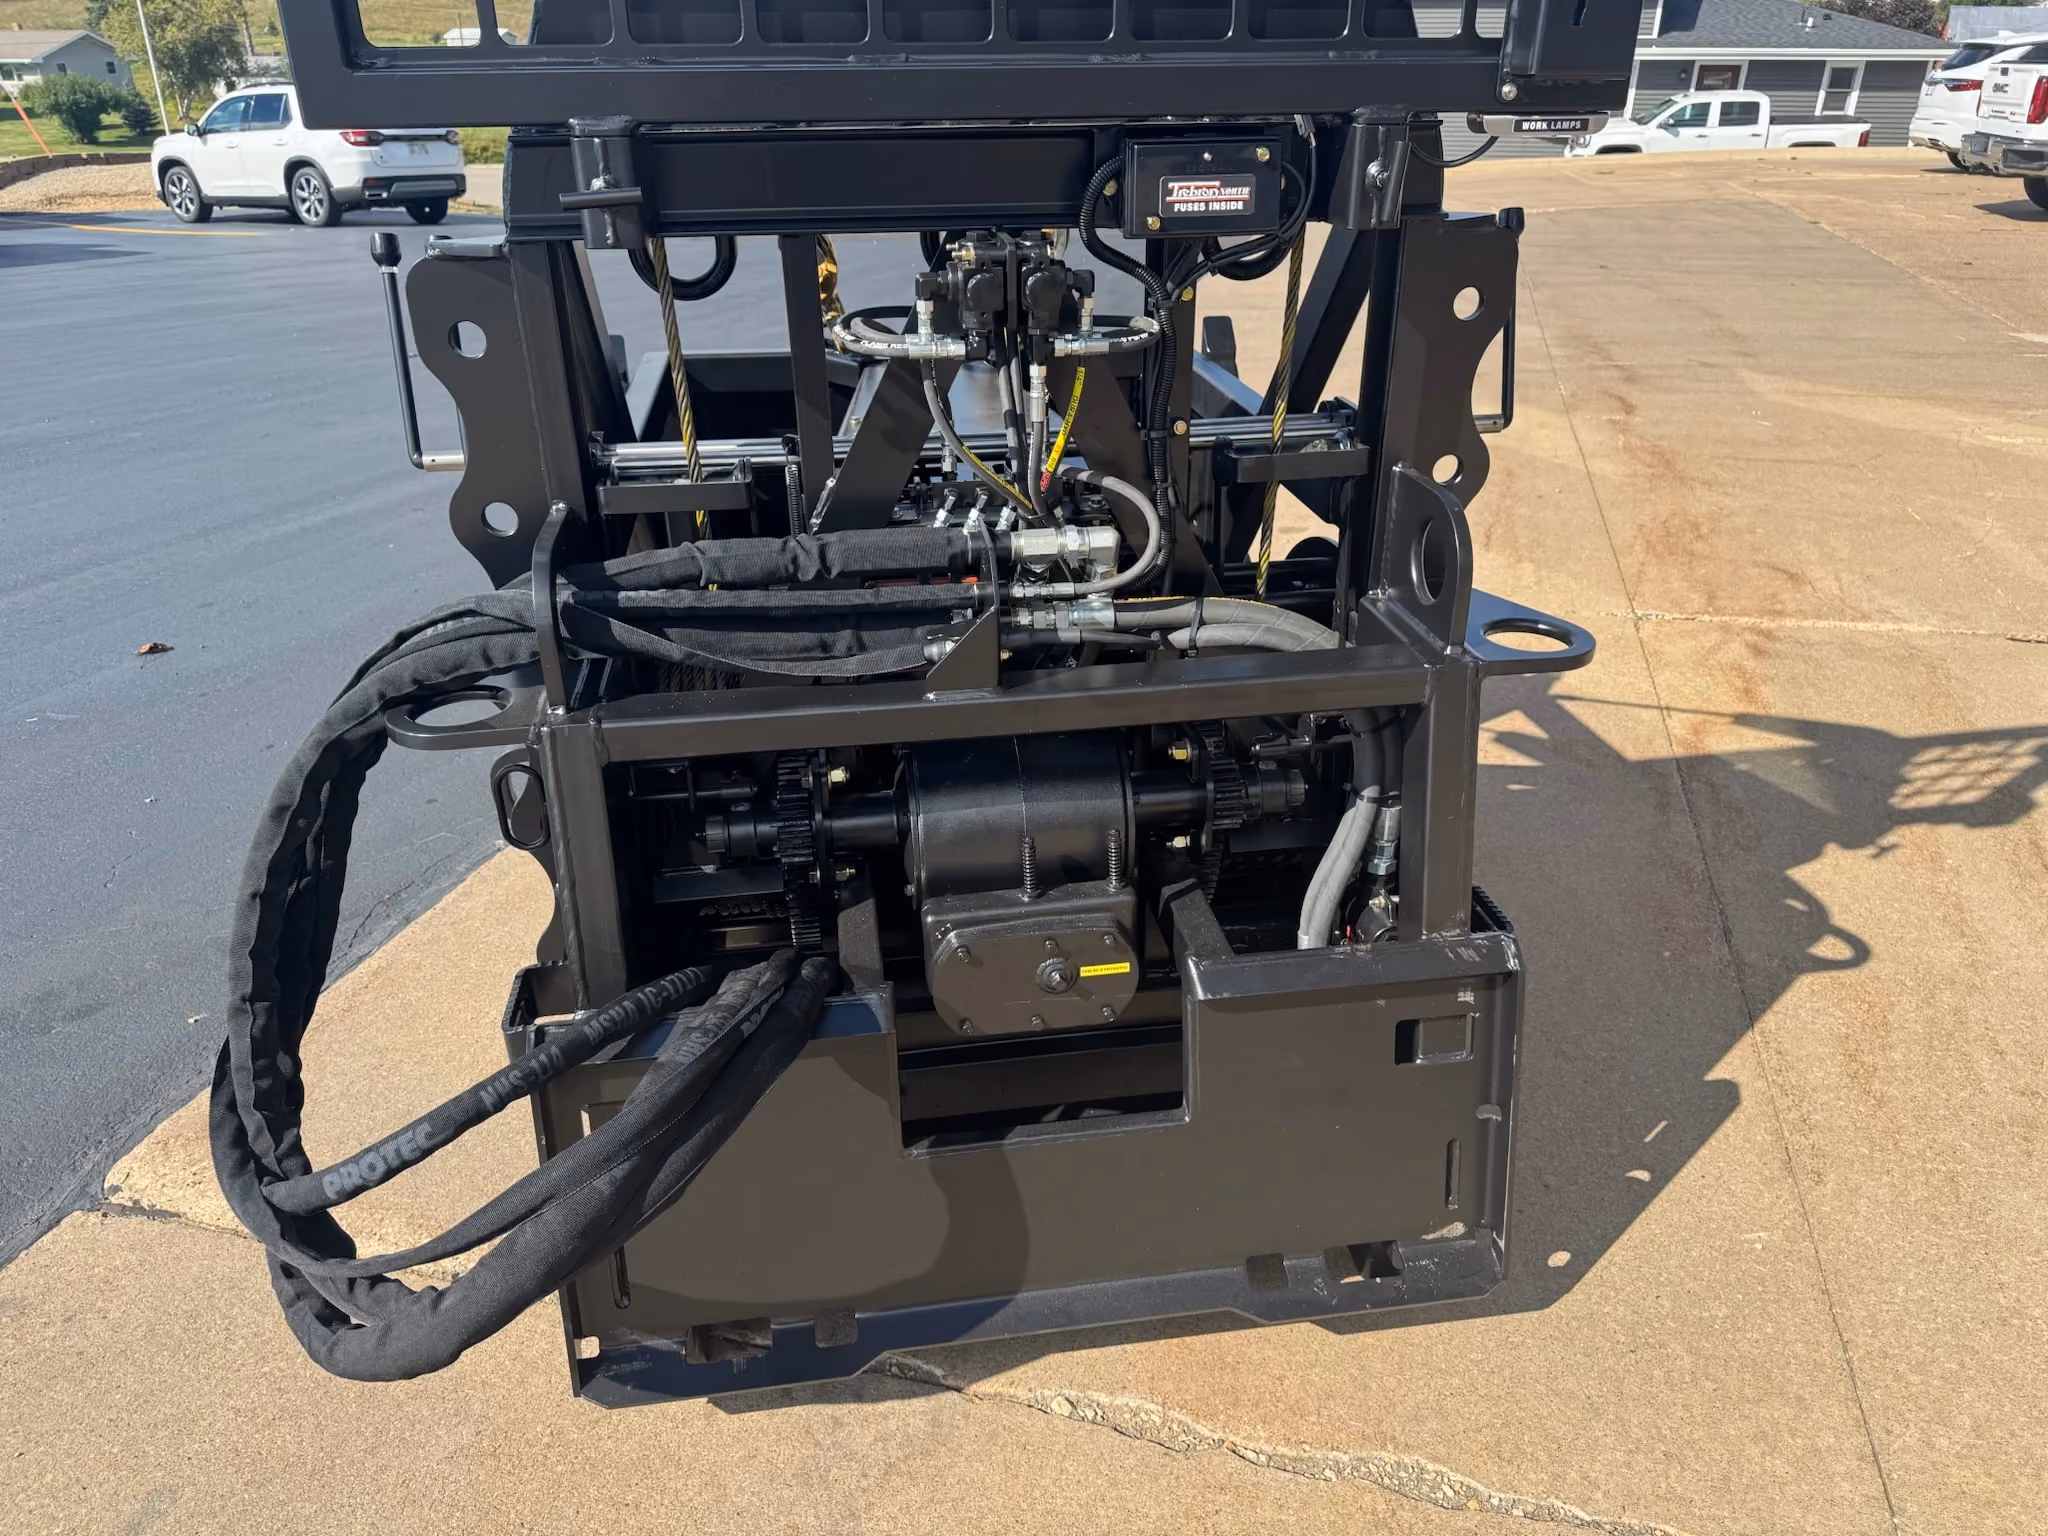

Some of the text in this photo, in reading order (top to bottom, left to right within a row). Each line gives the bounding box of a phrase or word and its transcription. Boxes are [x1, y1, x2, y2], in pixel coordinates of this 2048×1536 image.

[1522, 120, 1581, 130] WORK LAMPS
[1174, 200, 1244, 212] FUSES INSIDE
[322, 1122, 444, 1199] PROTEC
